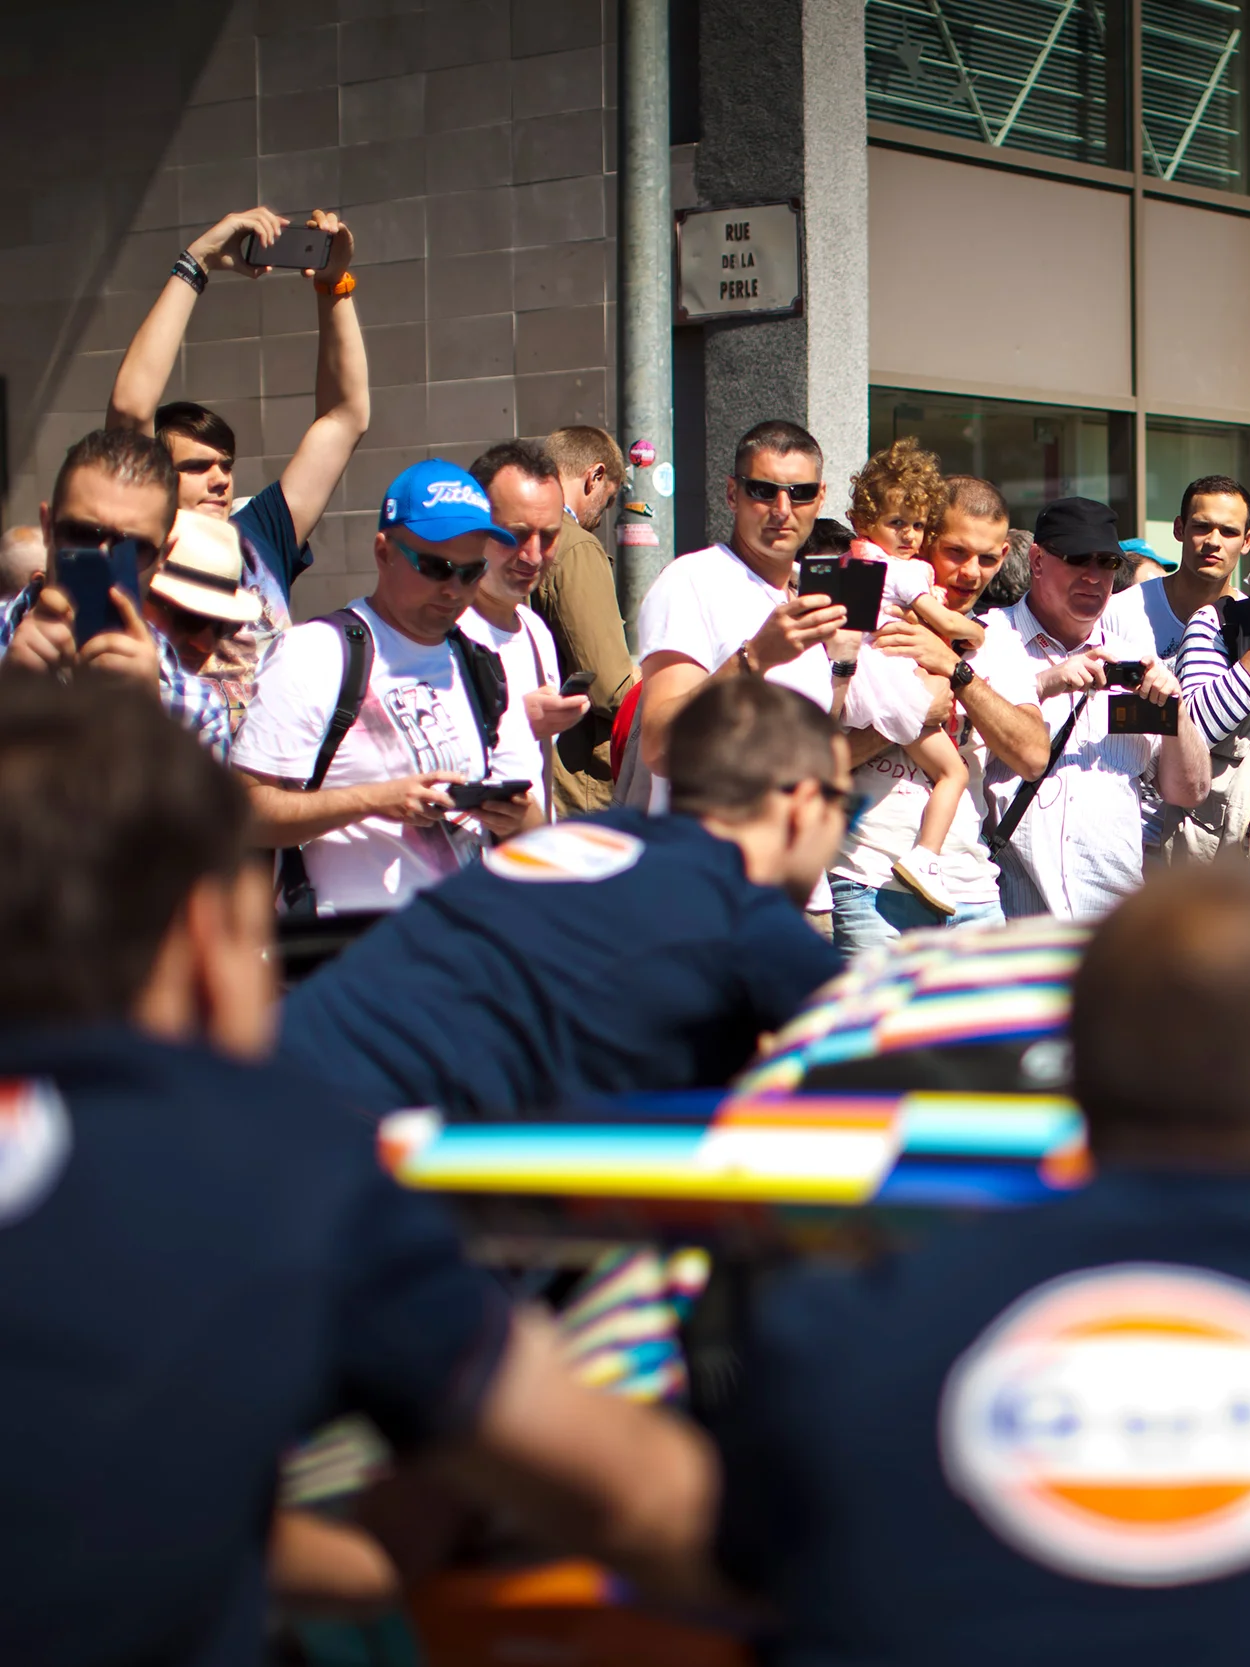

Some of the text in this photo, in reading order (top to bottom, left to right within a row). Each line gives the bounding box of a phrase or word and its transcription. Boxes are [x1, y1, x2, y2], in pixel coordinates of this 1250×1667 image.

[725, 222, 750, 242] RUE
[721, 252, 755, 269] DE LA
[719, 278, 758, 300] PERLE
